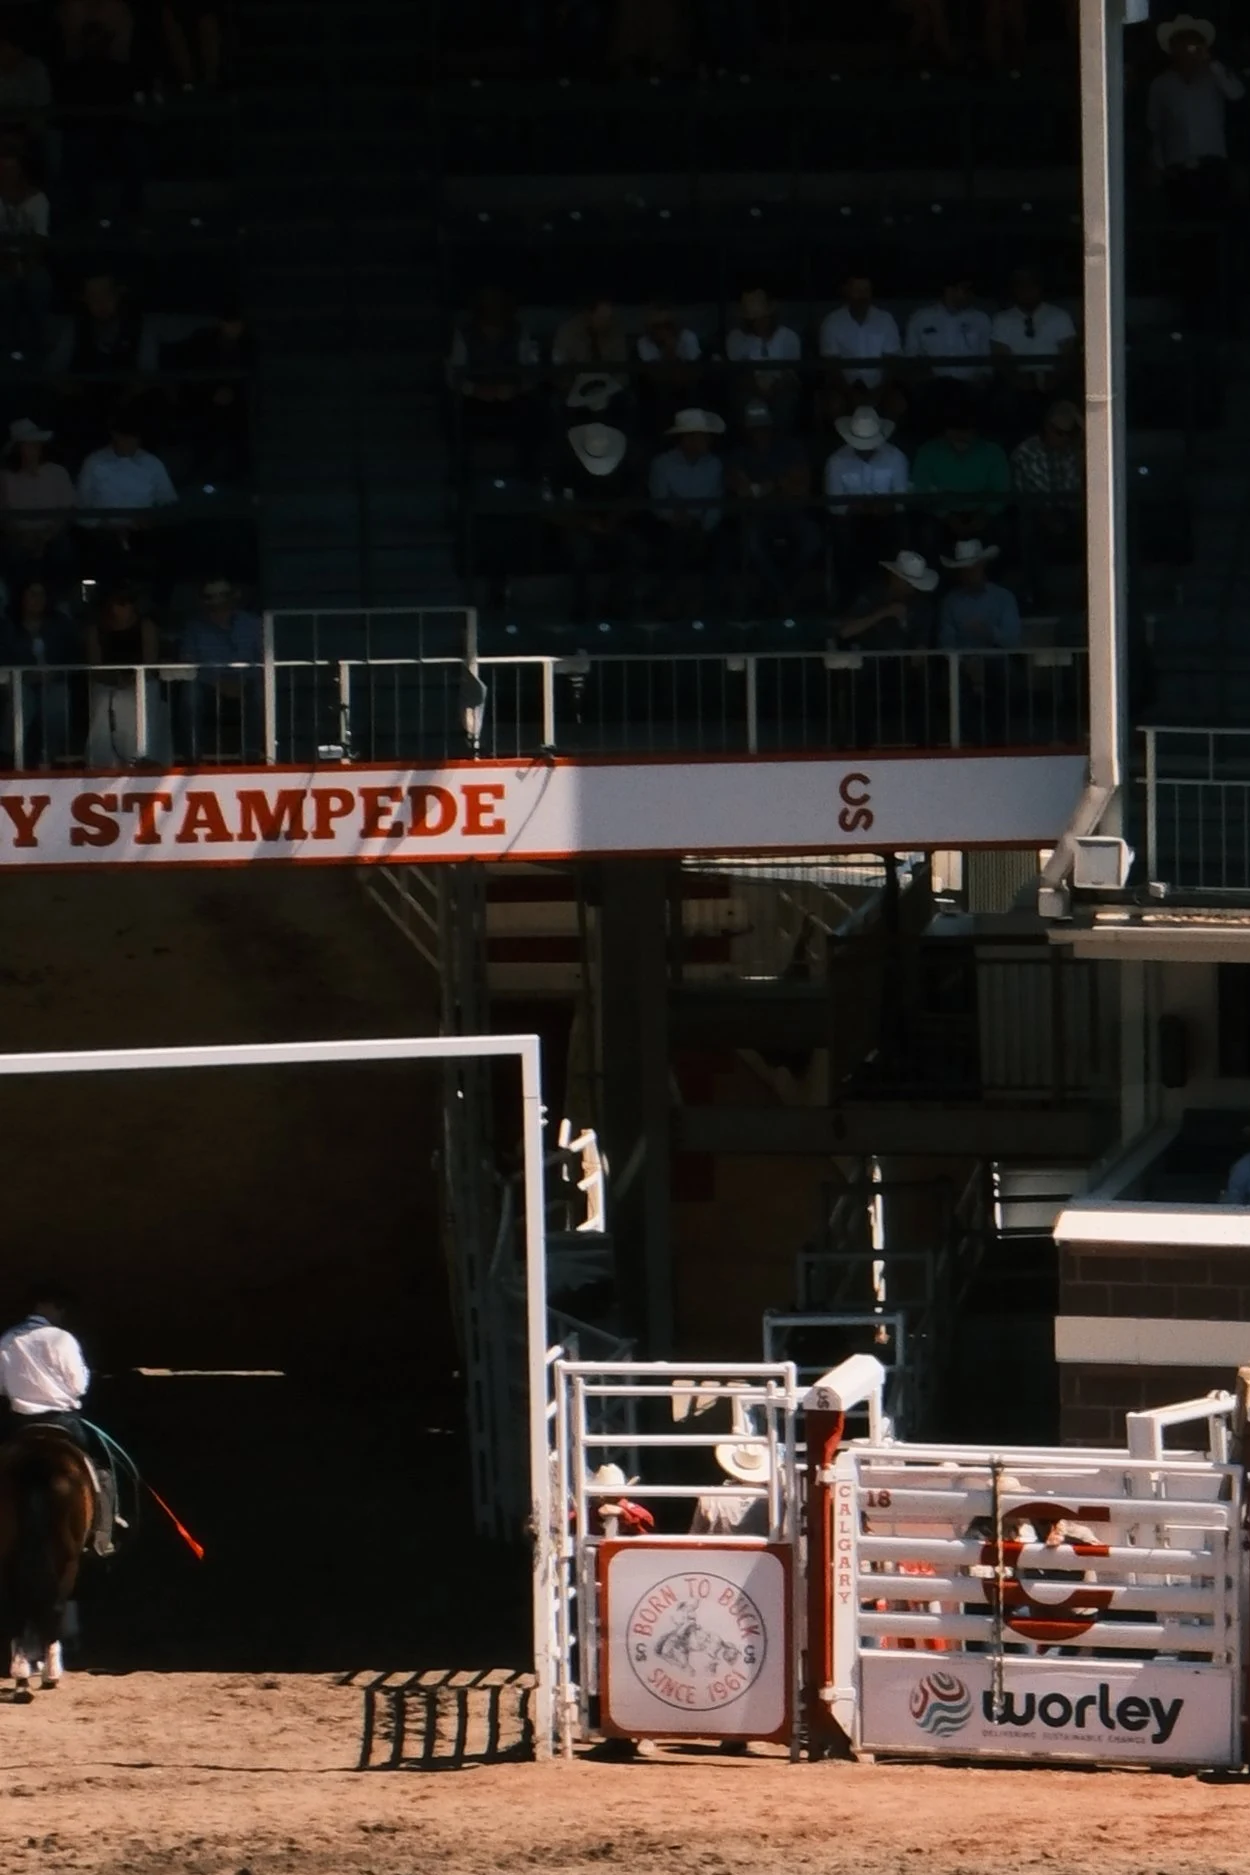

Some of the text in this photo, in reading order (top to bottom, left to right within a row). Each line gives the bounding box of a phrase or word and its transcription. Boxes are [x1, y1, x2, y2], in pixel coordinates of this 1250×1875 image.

[0, 784, 505, 848] Y STAMPEDE
[866, 1490, 892, 1508] 18
[838, 1485, 852, 1605] CALGARY
[633, 1577, 761, 1639] BORN TO BUCK
[648, 1667, 748, 1705] SINCE 1961
[982, 1683, 1184, 1744] worley
